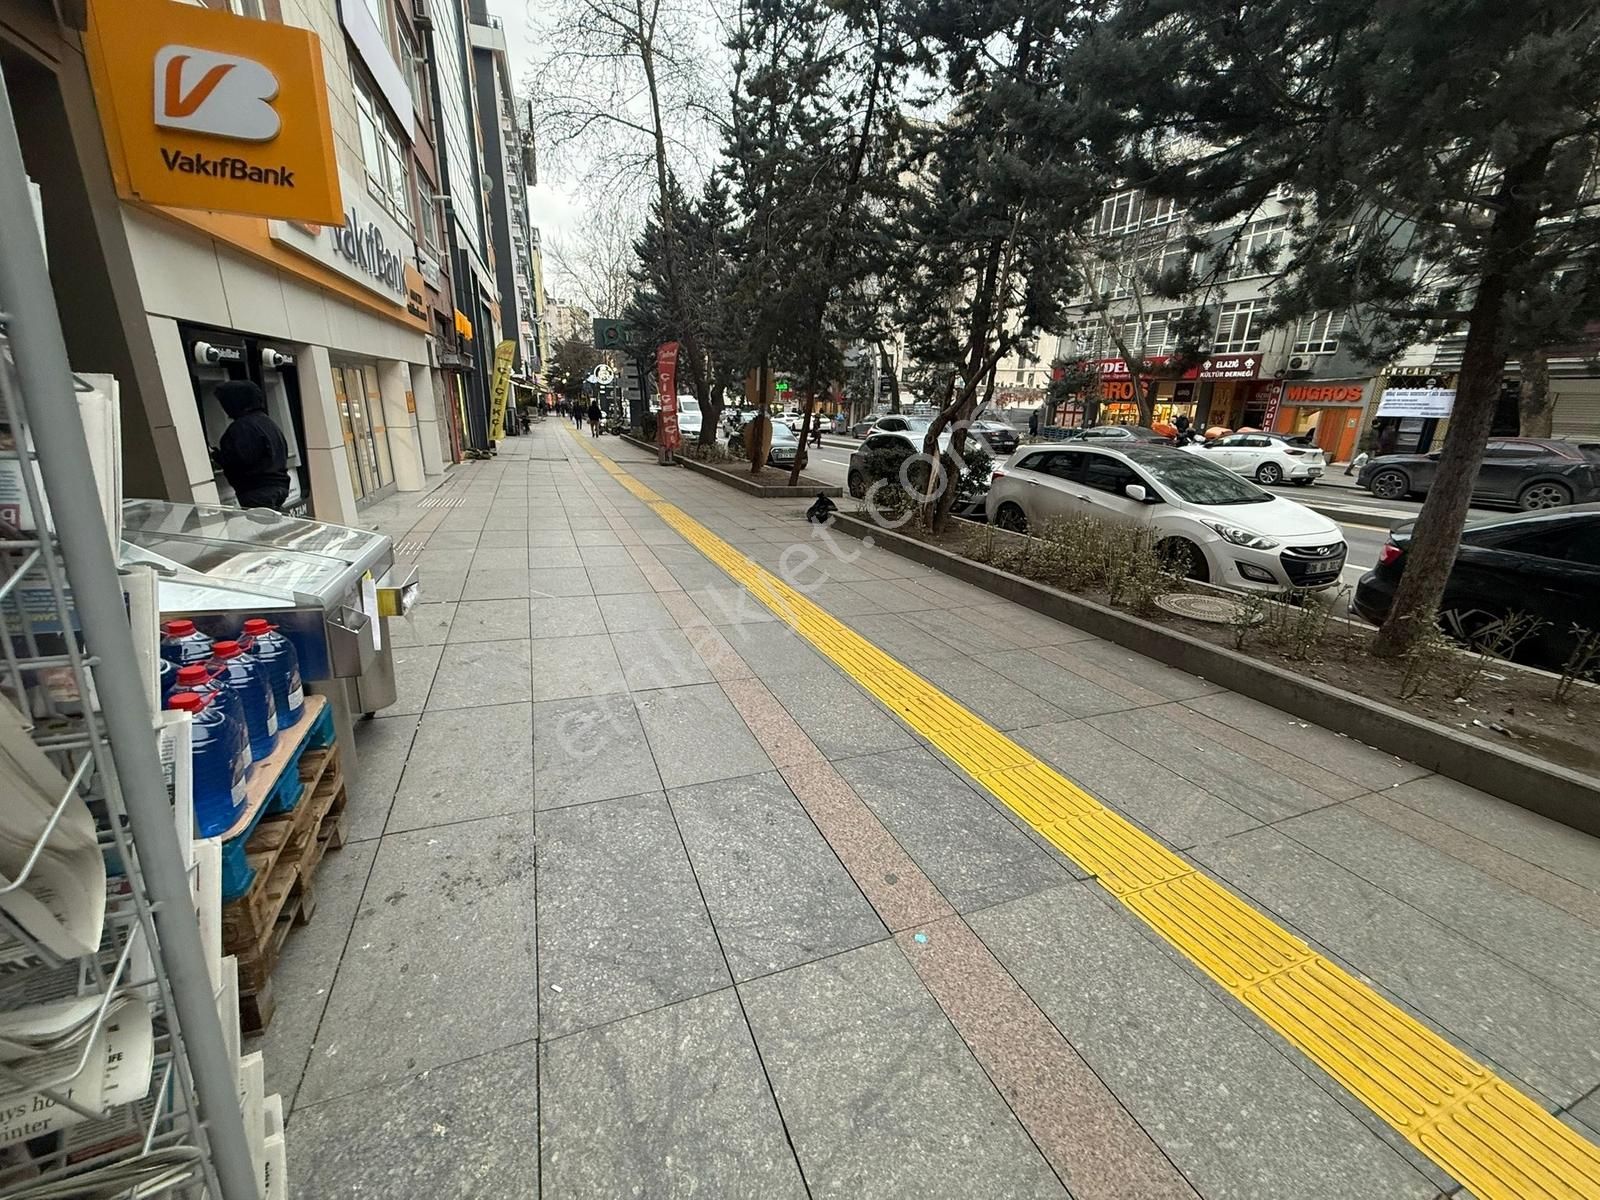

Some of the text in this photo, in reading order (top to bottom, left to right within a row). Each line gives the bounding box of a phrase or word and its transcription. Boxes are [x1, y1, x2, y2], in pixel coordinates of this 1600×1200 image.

[160, 147, 295, 188] VakıfBank
[1216, 359, 1240, 369] ELAZIĞ
[1200, 369, 1254, 378] KÜLTÜR DERNEĞİ
[0, 1118, 52, 1141] inter
